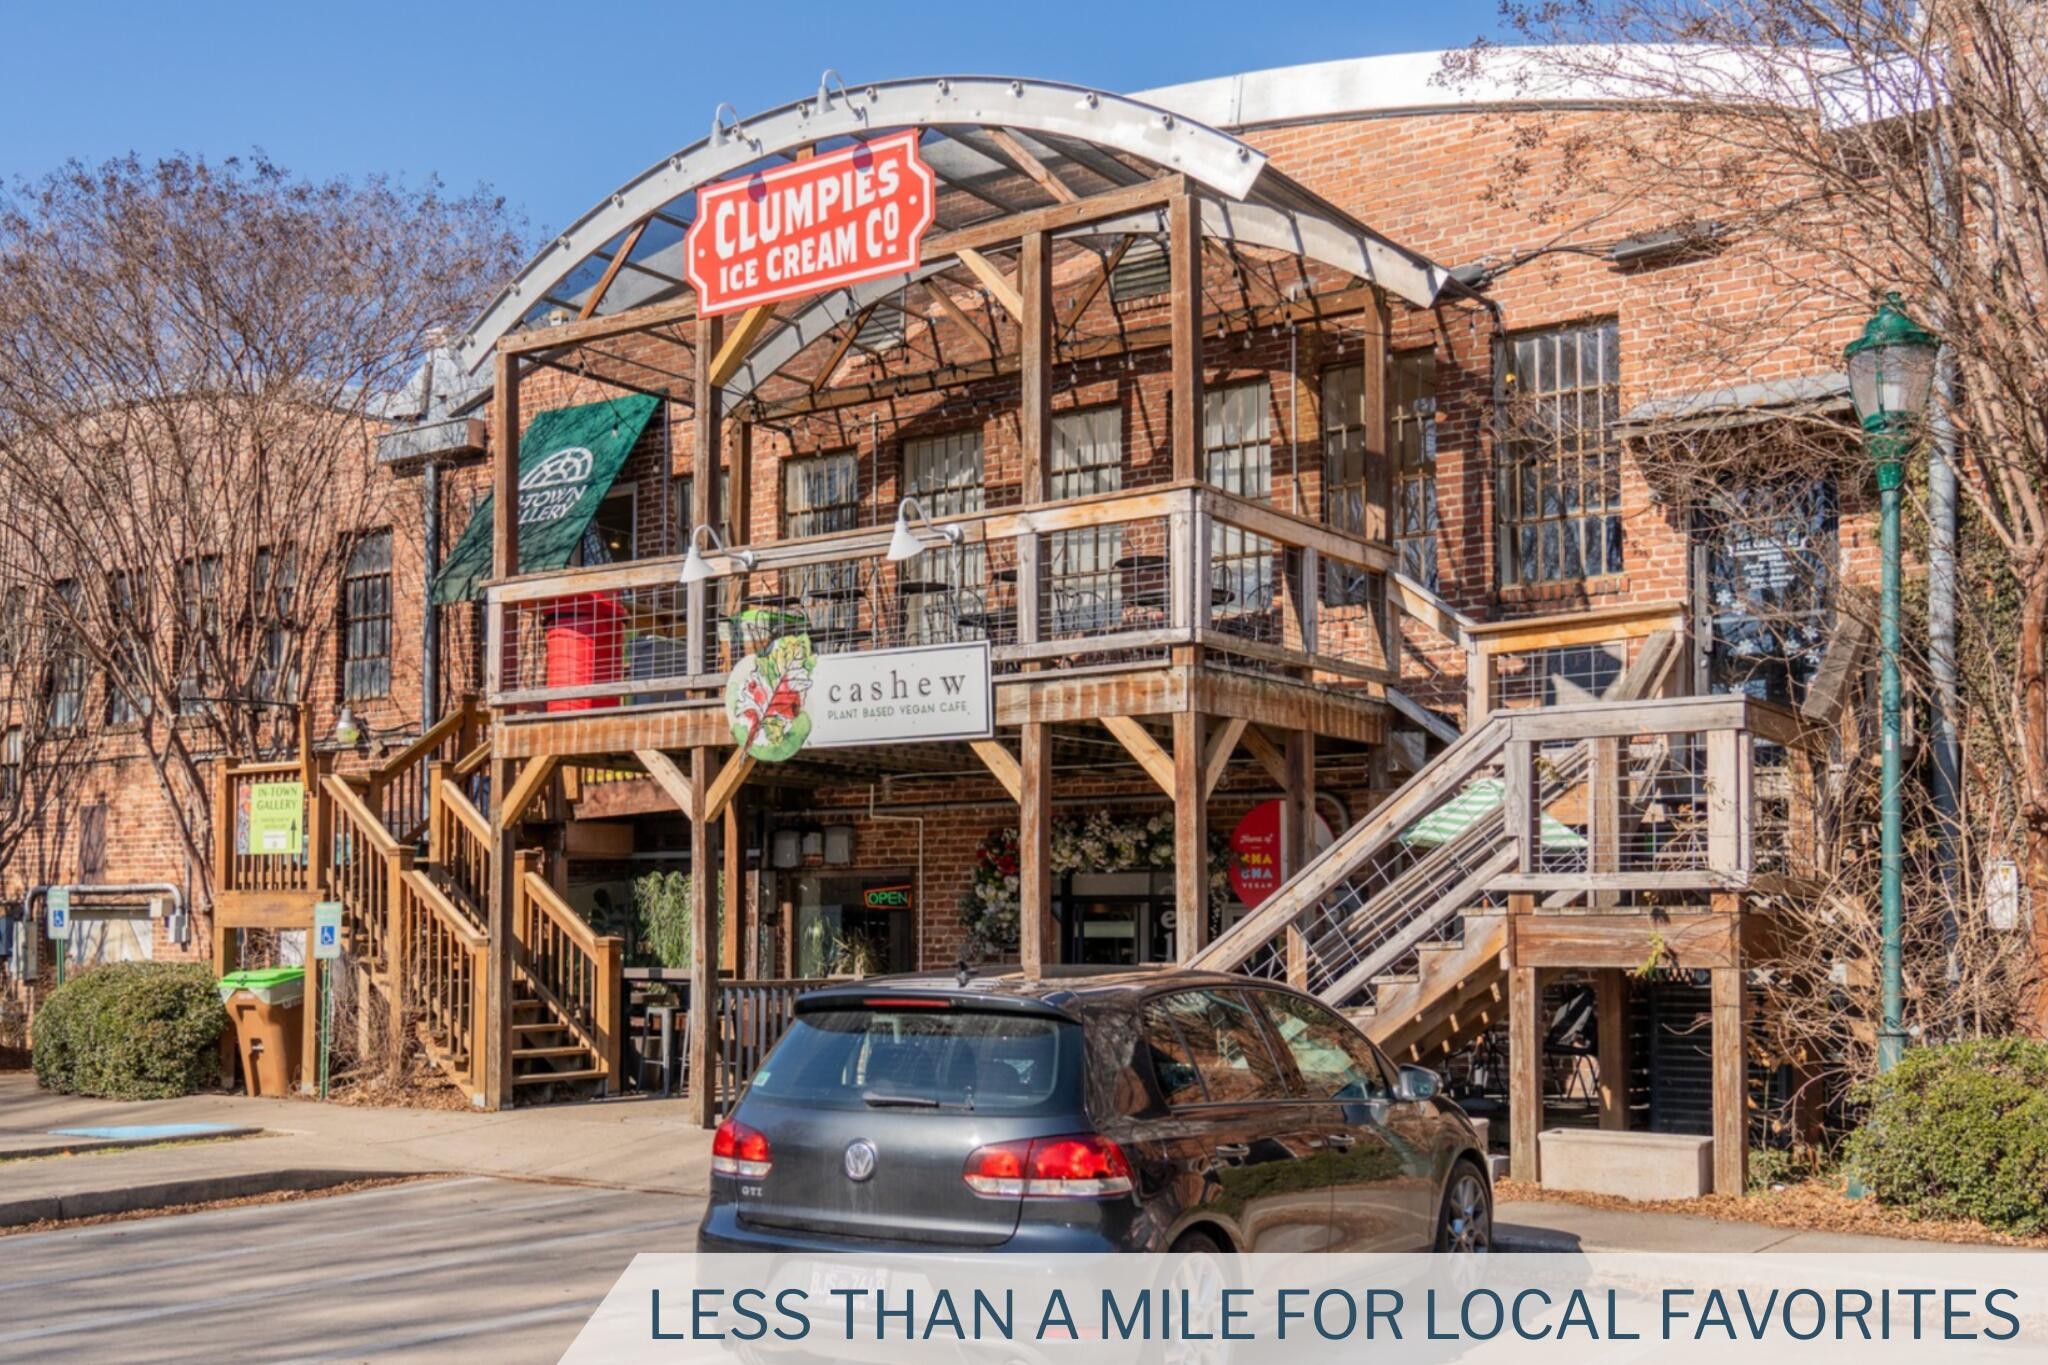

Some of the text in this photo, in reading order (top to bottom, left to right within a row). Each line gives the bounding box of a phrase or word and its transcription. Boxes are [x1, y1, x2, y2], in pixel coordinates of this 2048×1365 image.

[715, 158, 900, 260] CLUMPIES
[719, 258, 760, 294] ICE
[766, 221, 858, 283] CREAM
[518, 501, 575, 525] LLERY
[828, 670, 966, 703] cashew
[827, 701, 968, 720] PLANT BASED VEGAN CAFE
[258, 786, 298, 797] IN-TOWN
[256, 799, 297, 811] GALLERY
[869, 890, 908, 905] OPEN
[741, 1186, 762, 1197] GTI
